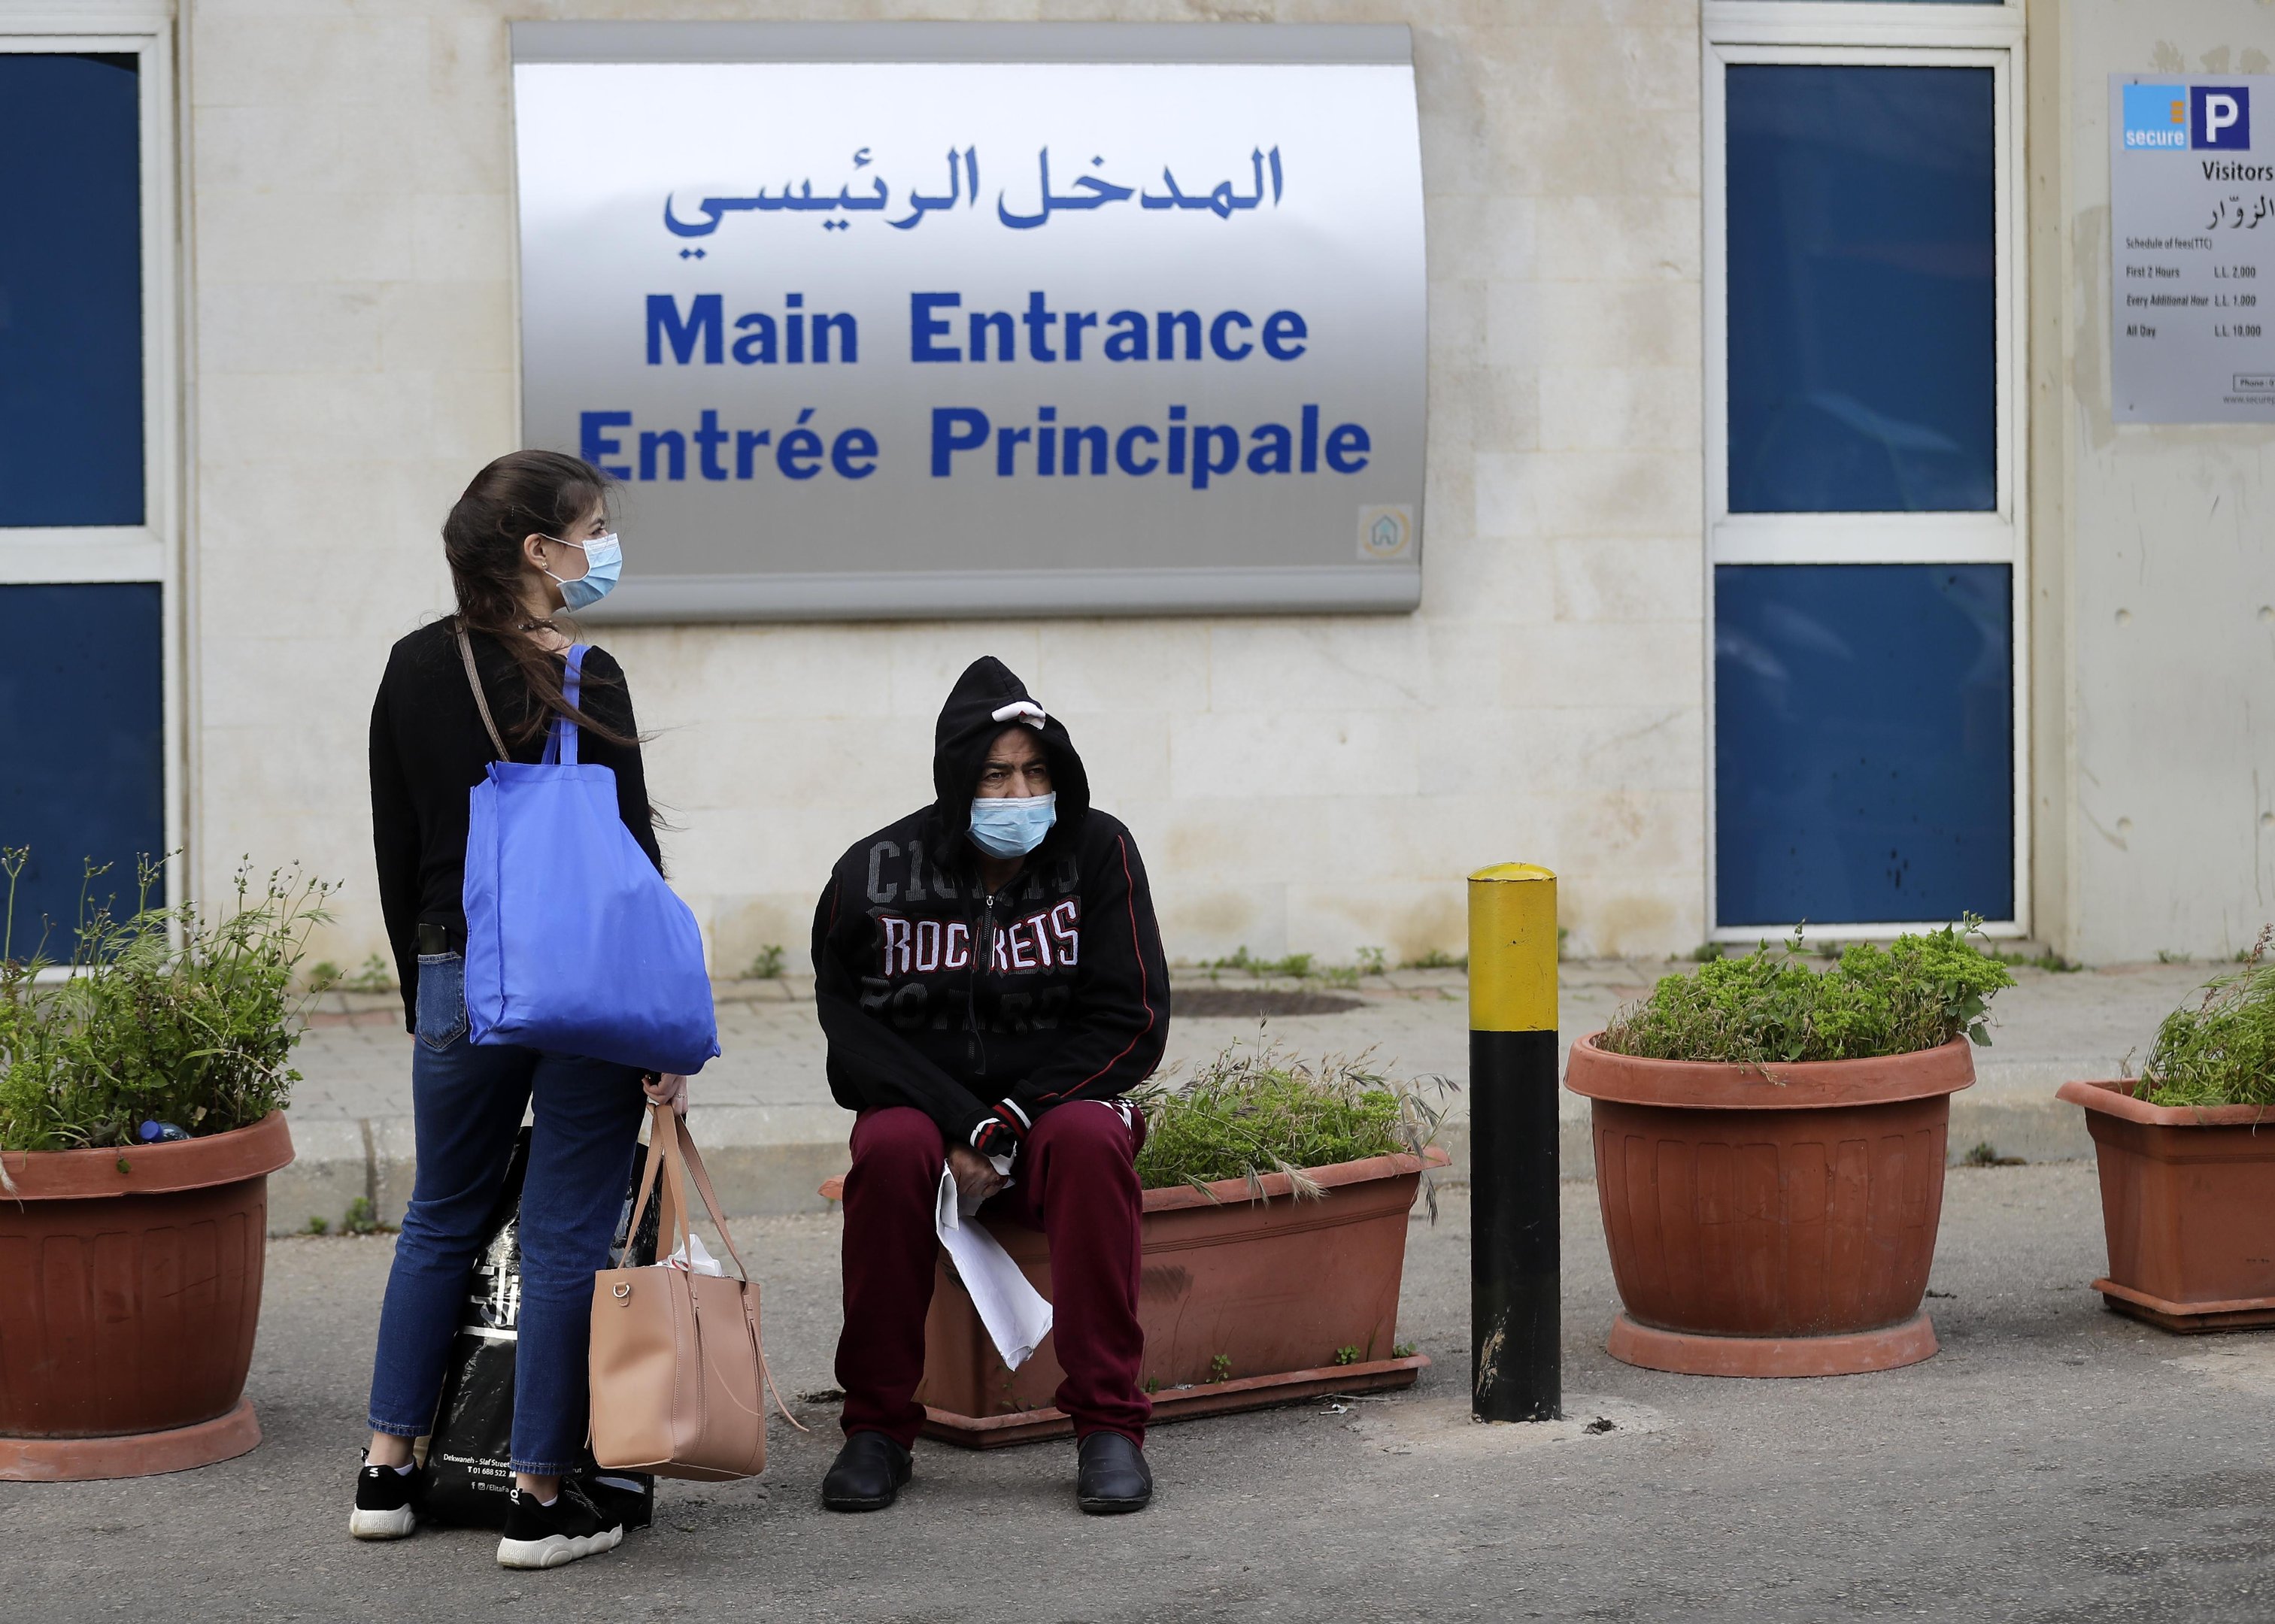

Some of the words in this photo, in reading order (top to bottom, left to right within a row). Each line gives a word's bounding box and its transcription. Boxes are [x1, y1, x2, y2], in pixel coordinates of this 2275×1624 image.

[2205, 93, 2238, 143] P
[2125, 129, 2185, 147] secure
[2201, 160, 2273, 181] Visitors
[997, 145, 1284, 229] المدخل
[663, 145, 979, 259] الرئيسي
[2125, 237, 2163, 250] Schedule
[2164, 237, 2173, 250] of
[2125, 265, 2145, 278] First
[2147, 265, 2152, 278] 2
[2155, 265, 2180, 278] Hours
[2125, 293, 2148, 308] Every
[2150, 293, 2189, 307] Additional
[2190, 294, 2209, 307] Hour
[645, 292, 859, 366] Main
[909, 289, 1309, 364] Entrance
[2126, 324, 2137, 337] All
[2140, 323, 2156, 338] Day
[579, 408, 879, 482] Entrée
[930, 403, 1372, 490] Principale
[443, 1453, 475, 1464] Dekwaneh
[479, 1457, 491, 1466] Slaf
[491, 1459, 510, 1468] Street
[482, 1468, 494, 1476] 688
[495, 1469, 507, 1477] 522
